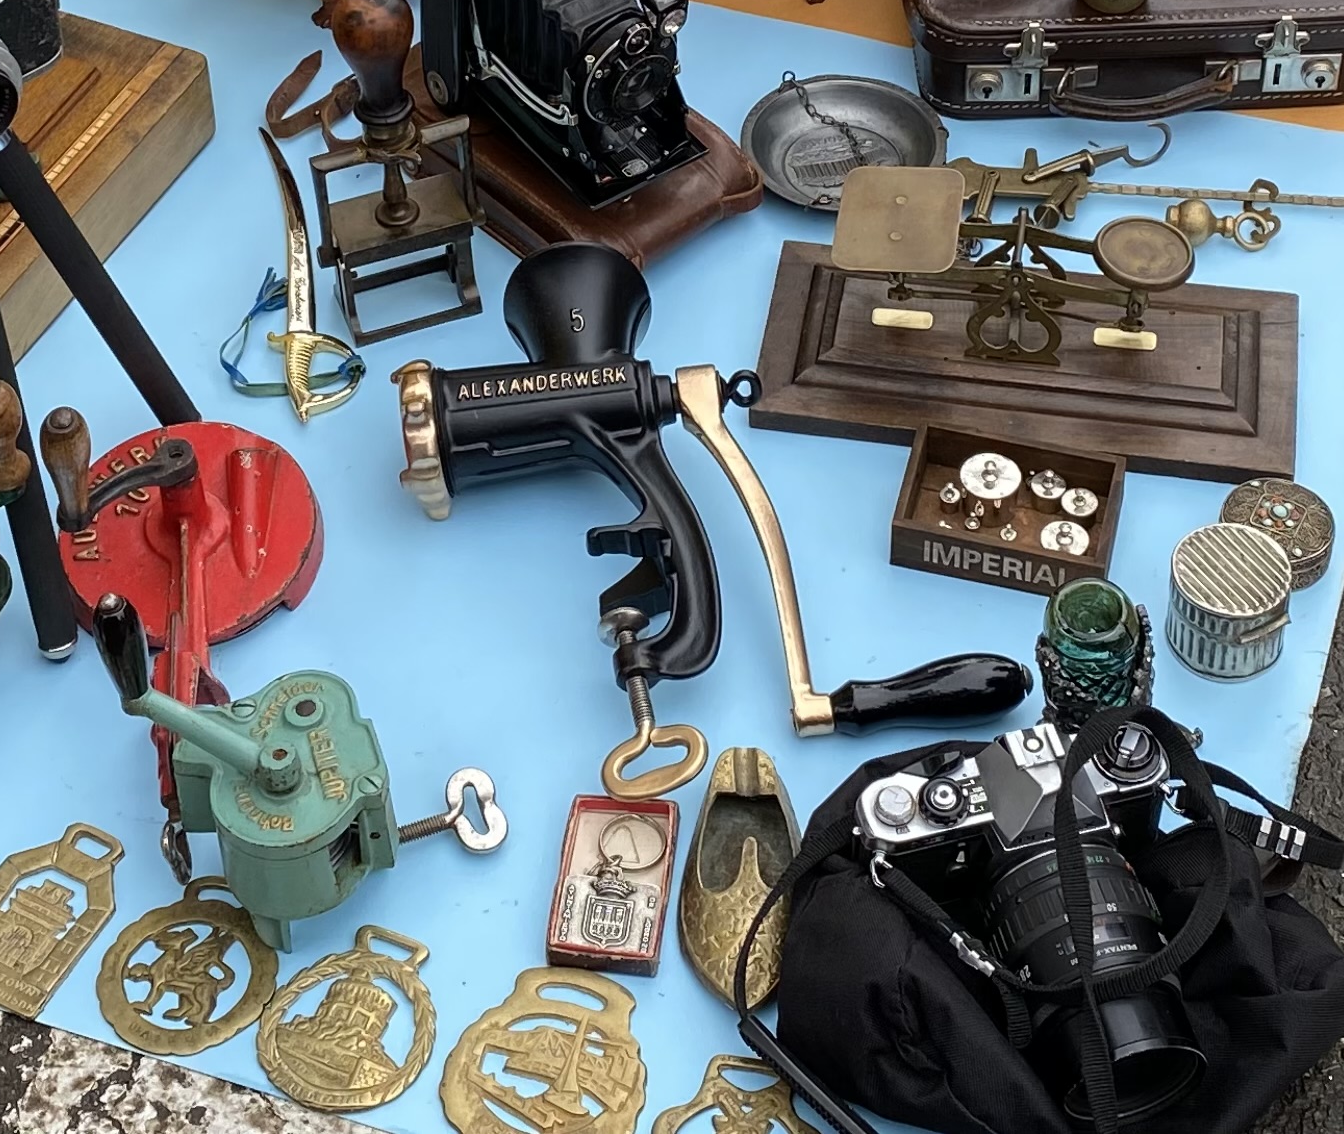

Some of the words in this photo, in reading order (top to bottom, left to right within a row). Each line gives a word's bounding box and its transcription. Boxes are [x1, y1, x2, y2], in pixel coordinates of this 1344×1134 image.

[570, 307, 585, 333] 5
[457, 366, 627, 401] ALEXANDERWERK
[308, 727, 349, 805] JUPITER
